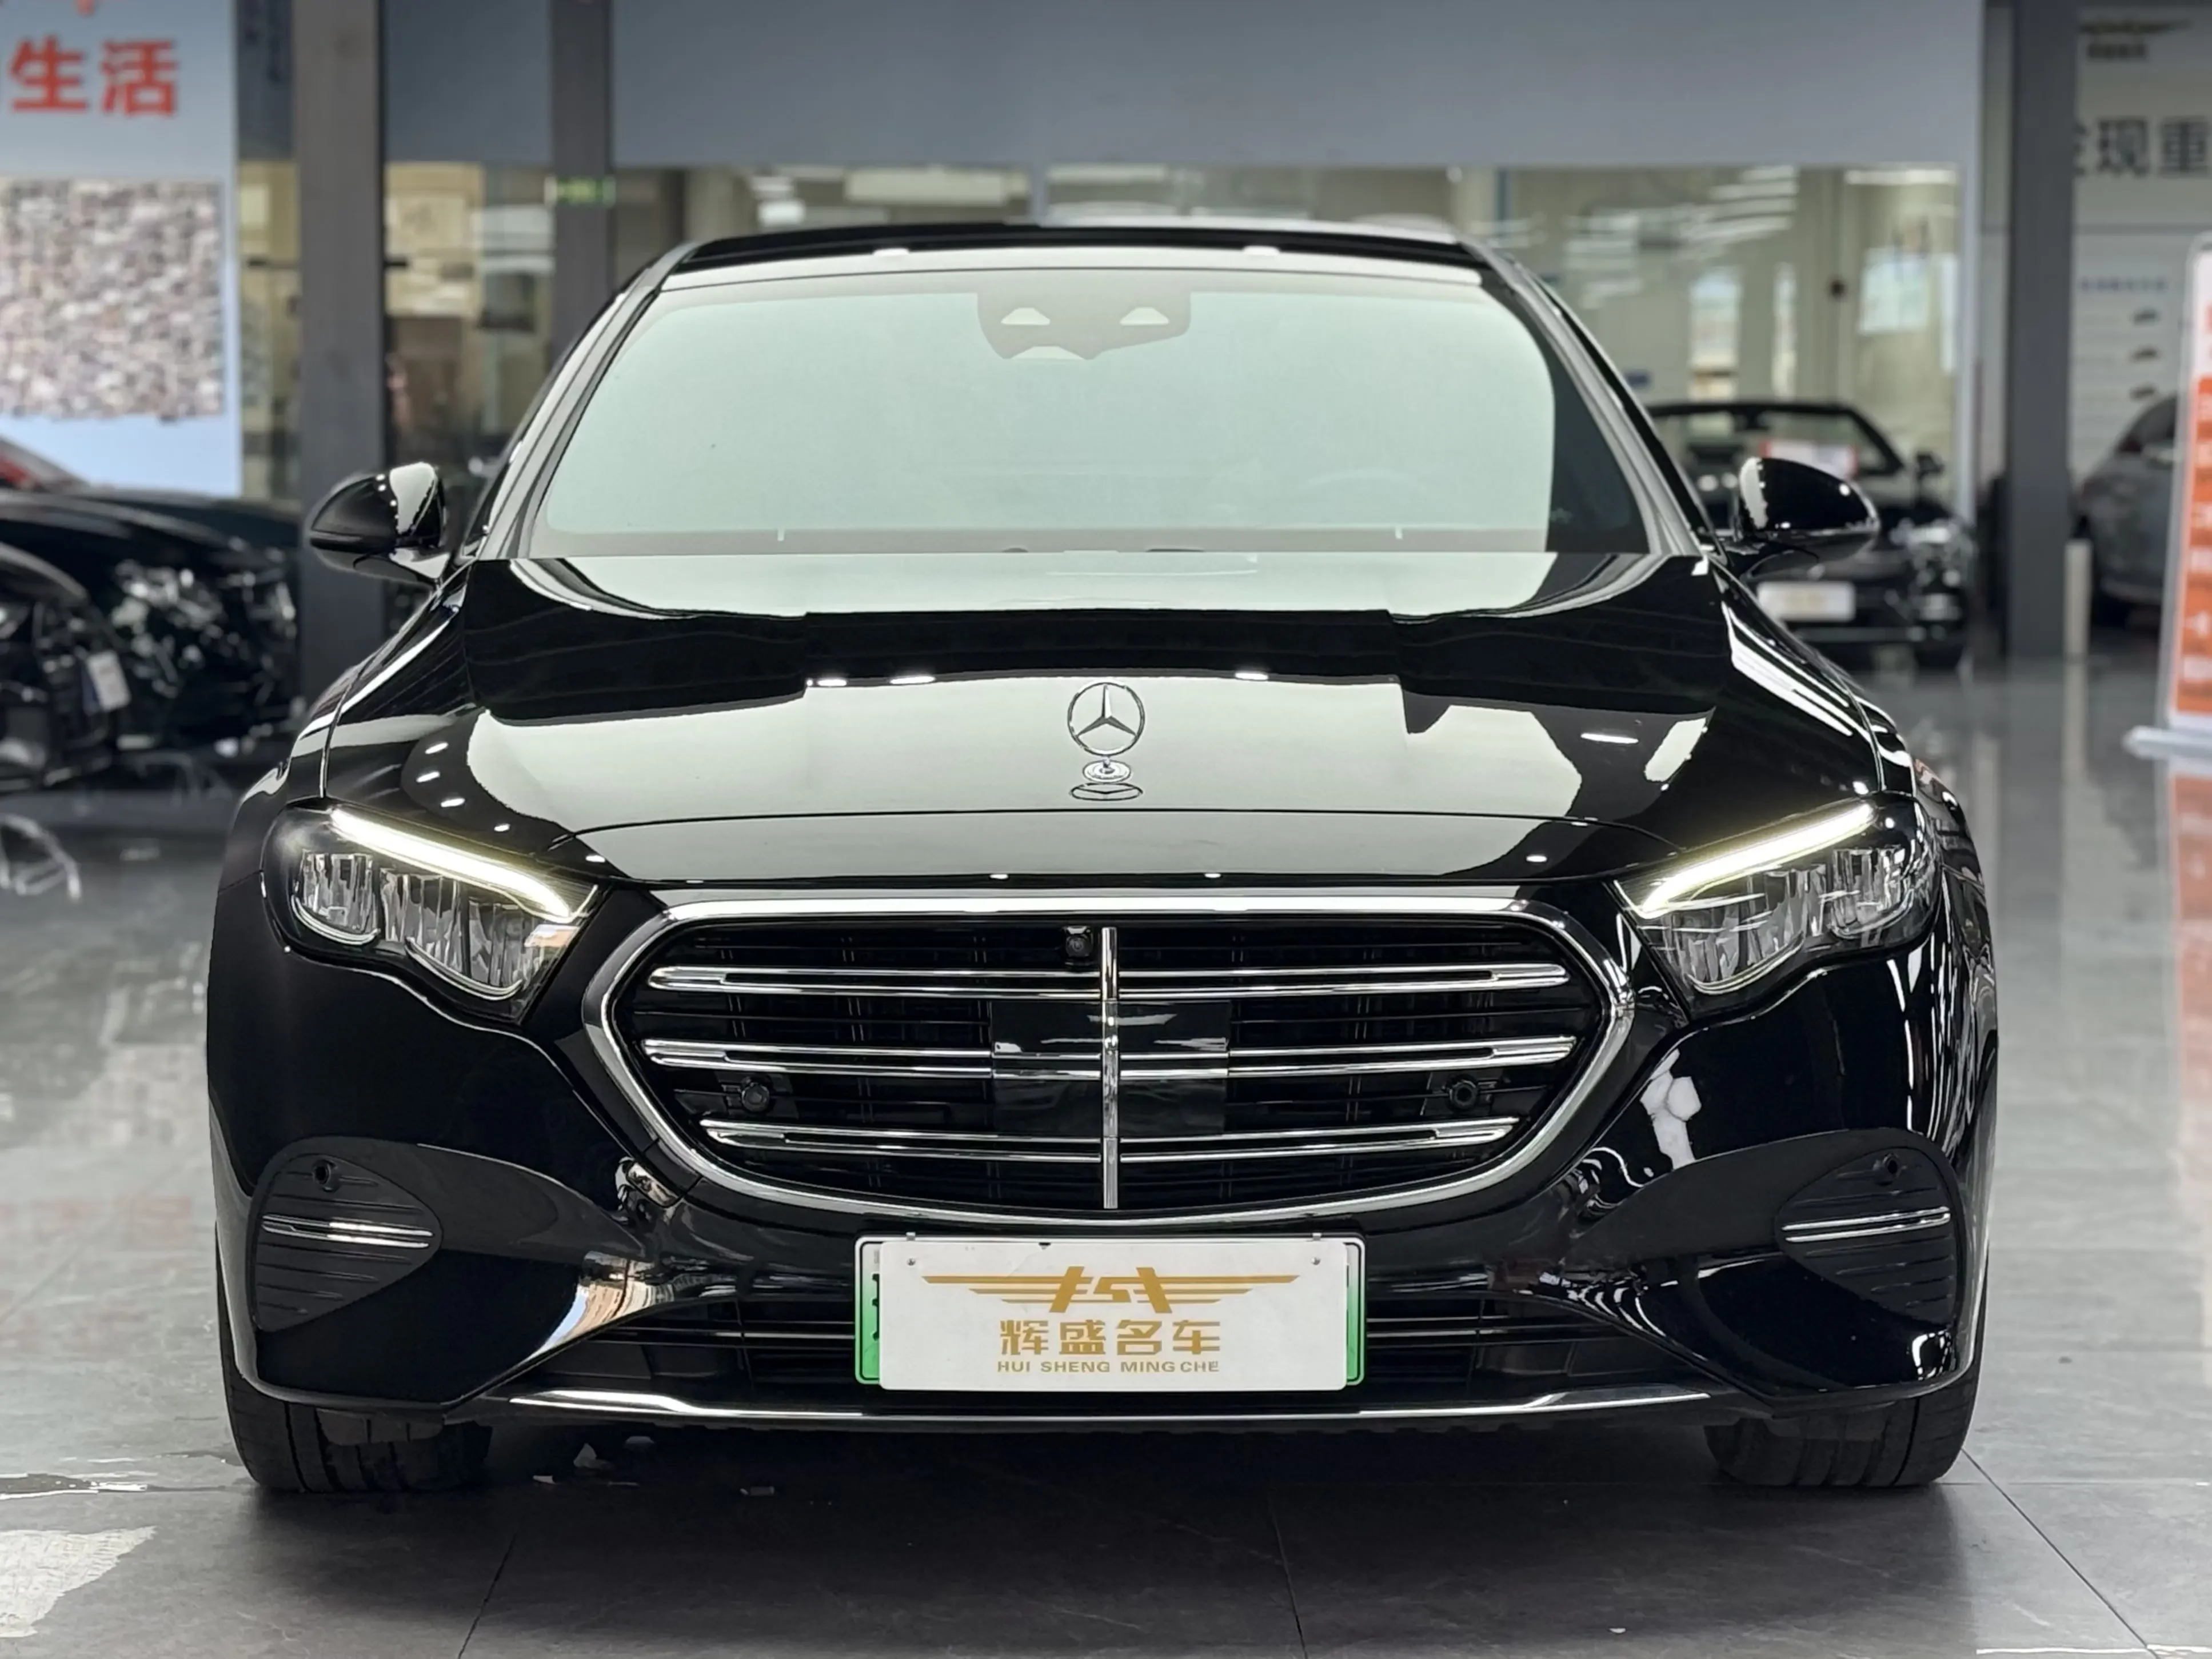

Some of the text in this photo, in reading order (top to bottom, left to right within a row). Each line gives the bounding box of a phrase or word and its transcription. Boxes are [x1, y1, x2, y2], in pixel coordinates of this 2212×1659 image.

[11, 34, 179, 115] 生活
[1000, 1319, 1220, 1356] 辉盛名车
[998, 1361, 1031, 1372] HUI
[1040, 1361, 1110, 1372] SHENG
